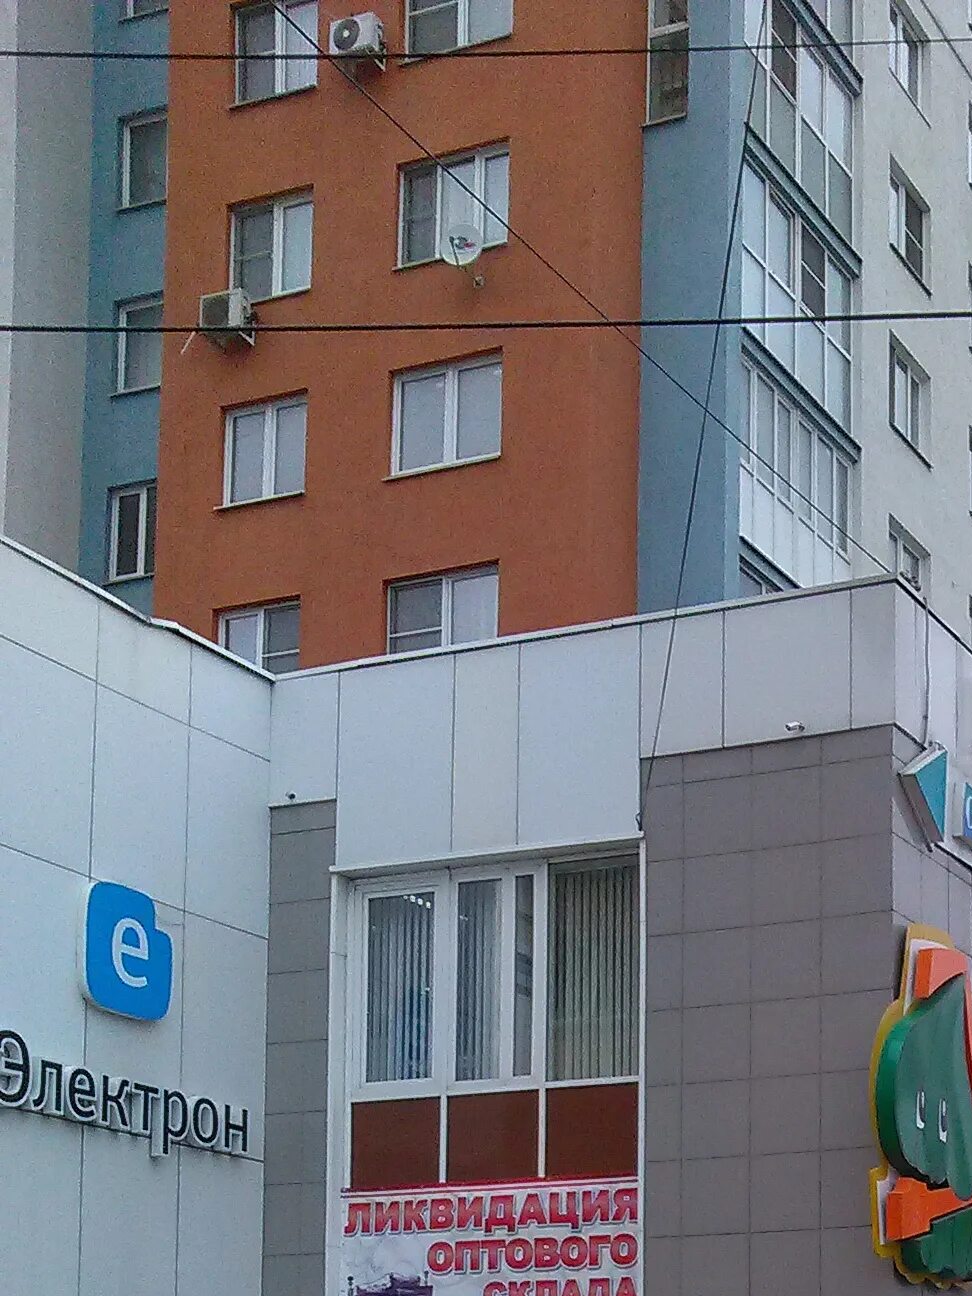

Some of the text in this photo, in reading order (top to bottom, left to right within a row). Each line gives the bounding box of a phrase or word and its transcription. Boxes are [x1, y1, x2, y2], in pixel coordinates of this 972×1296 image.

[0, 1029, 249, 1156] Электрон
[343, 1188, 639, 1236] ЛИКВИДАЦИЯ
[427, 1233, 639, 1273] ОПТОВОГО
